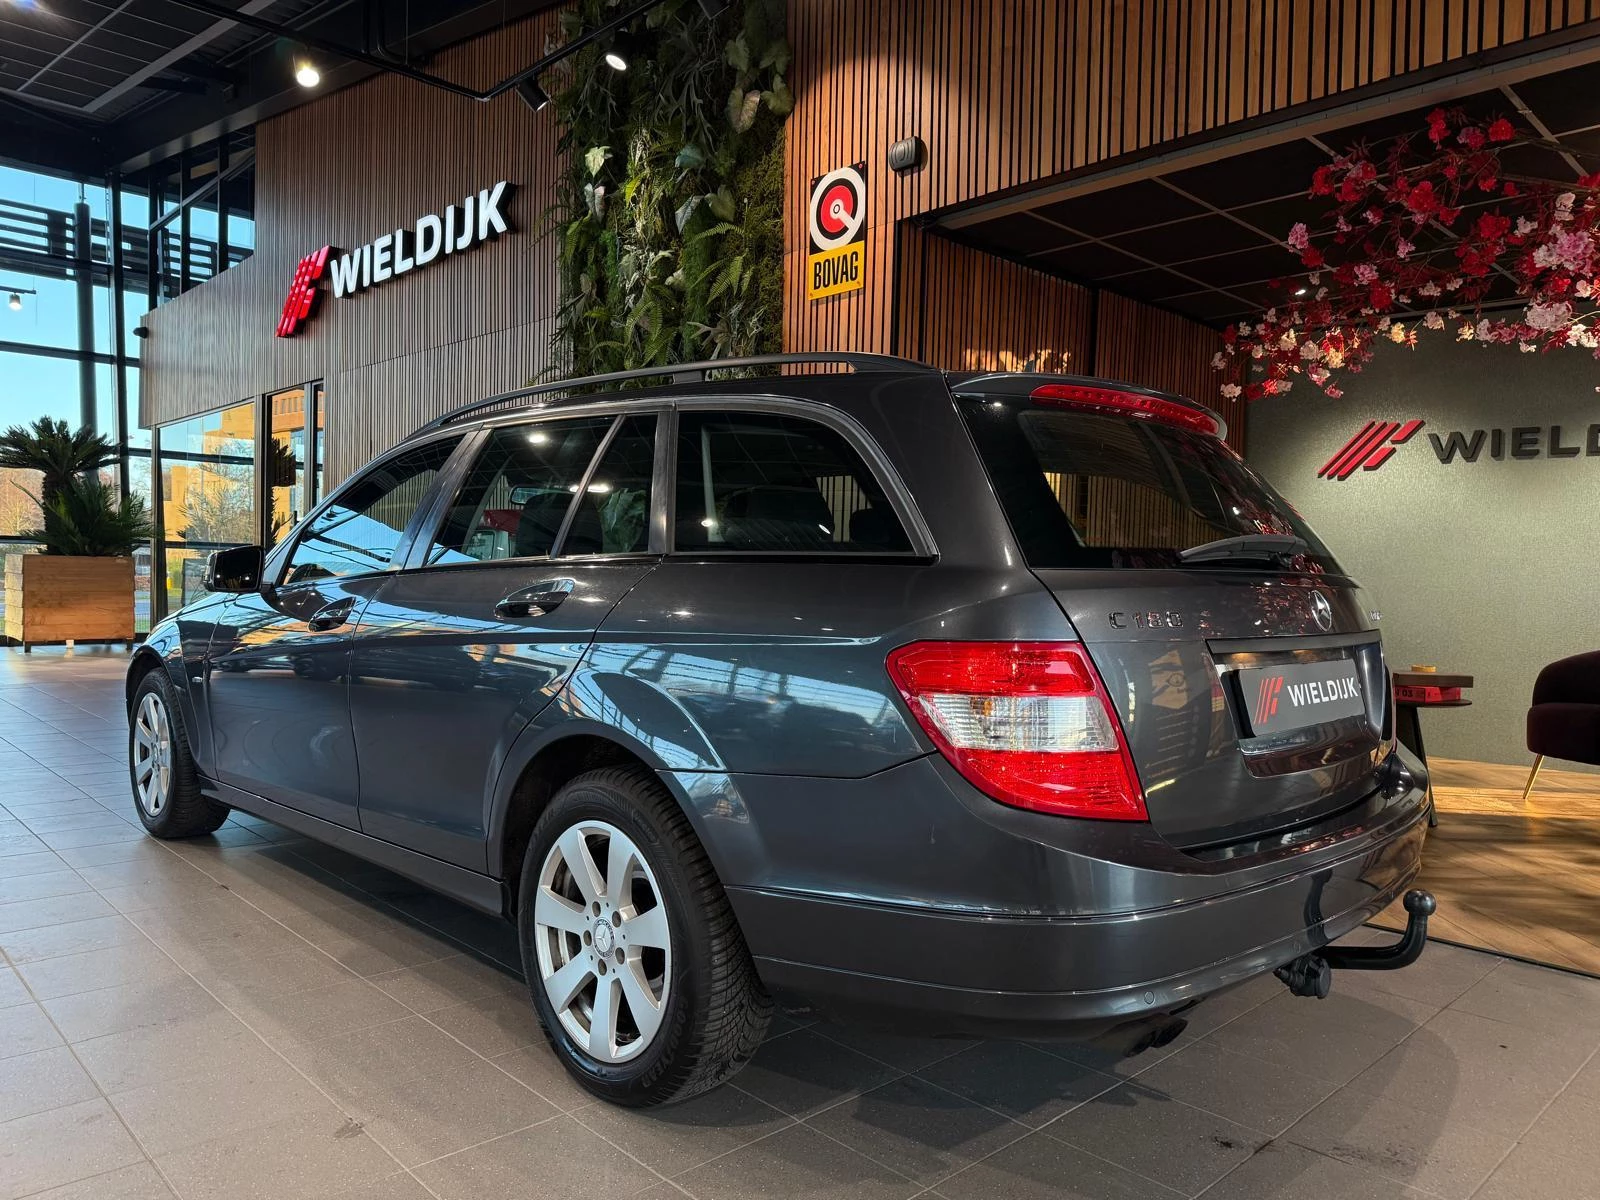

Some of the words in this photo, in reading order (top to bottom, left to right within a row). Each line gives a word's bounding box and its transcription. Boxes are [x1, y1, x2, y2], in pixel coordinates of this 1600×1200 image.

[330, 180, 510, 298] WIELDIJK
[813, 250, 859, 290] BOVAG
[1108, 611, 1127, 630] C
[1132, 610, 1184, 629] 180
[1287, 676, 1359, 707] WIELDIJK
